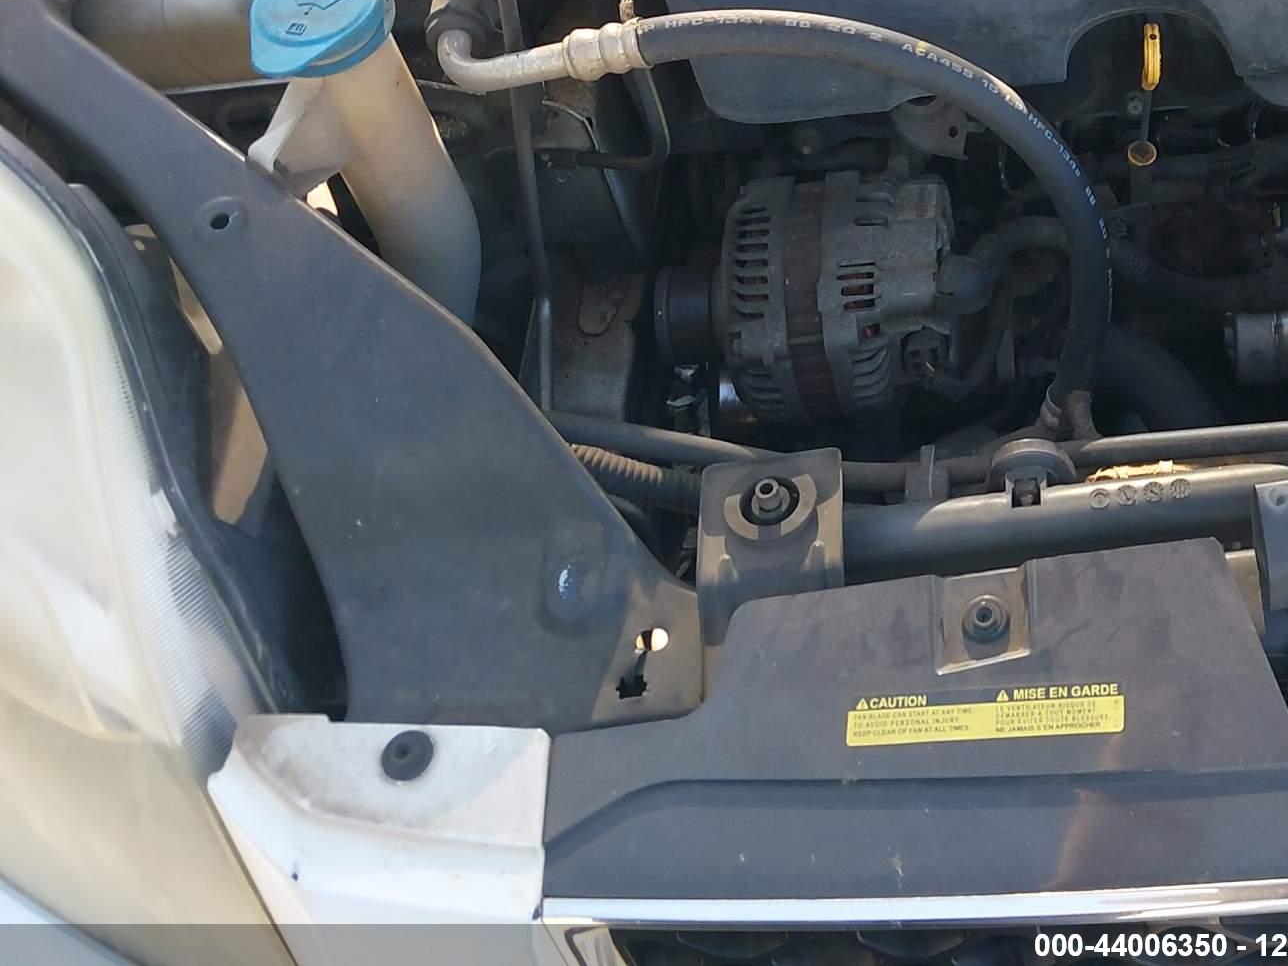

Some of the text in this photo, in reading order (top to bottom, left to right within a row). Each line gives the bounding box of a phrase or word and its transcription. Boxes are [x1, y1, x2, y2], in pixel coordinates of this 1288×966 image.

[1013, 684, 1119, 701] MISE EN GARDE
[869, 695, 927, 709] CAUTION
[866, 720, 888, 728] AVOID
